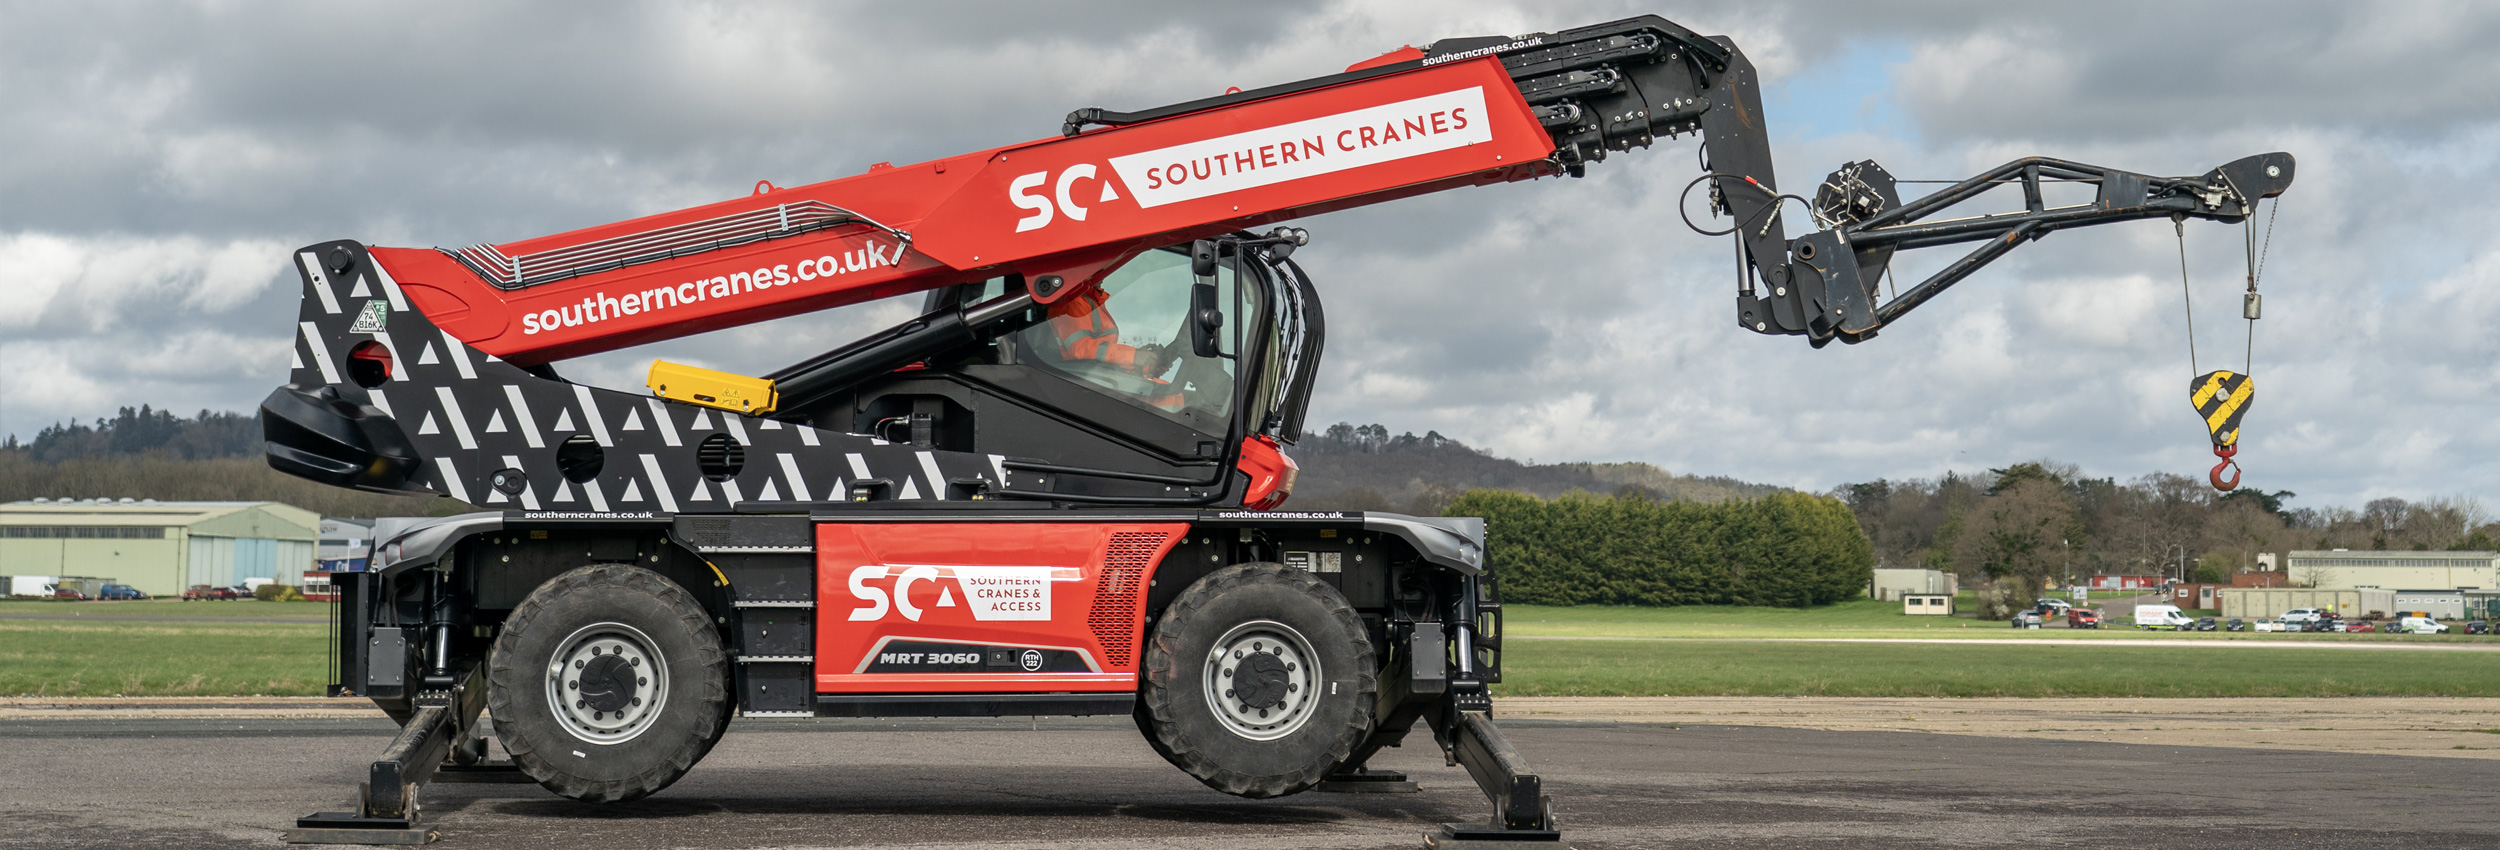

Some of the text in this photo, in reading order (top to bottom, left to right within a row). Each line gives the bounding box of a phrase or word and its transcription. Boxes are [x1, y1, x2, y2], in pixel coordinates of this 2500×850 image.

[1422, 37, 1543, 67] southerncranes.co.uk
[1146, 107, 1468, 190] SOUTHERN CRANES
[523, 240, 889, 336] southerncranes.co.uk
[364, 312, 374, 320] 74
[524, 511, 653, 519] southerncranes.co.uk
[1219, 510, 1344, 519] southerncranes.co.uk
[977, 588, 1041, 599] CRANES &
[991, 601, 1041, 611] ACCESS
[880, 653, 980, 664] MRT 3060
